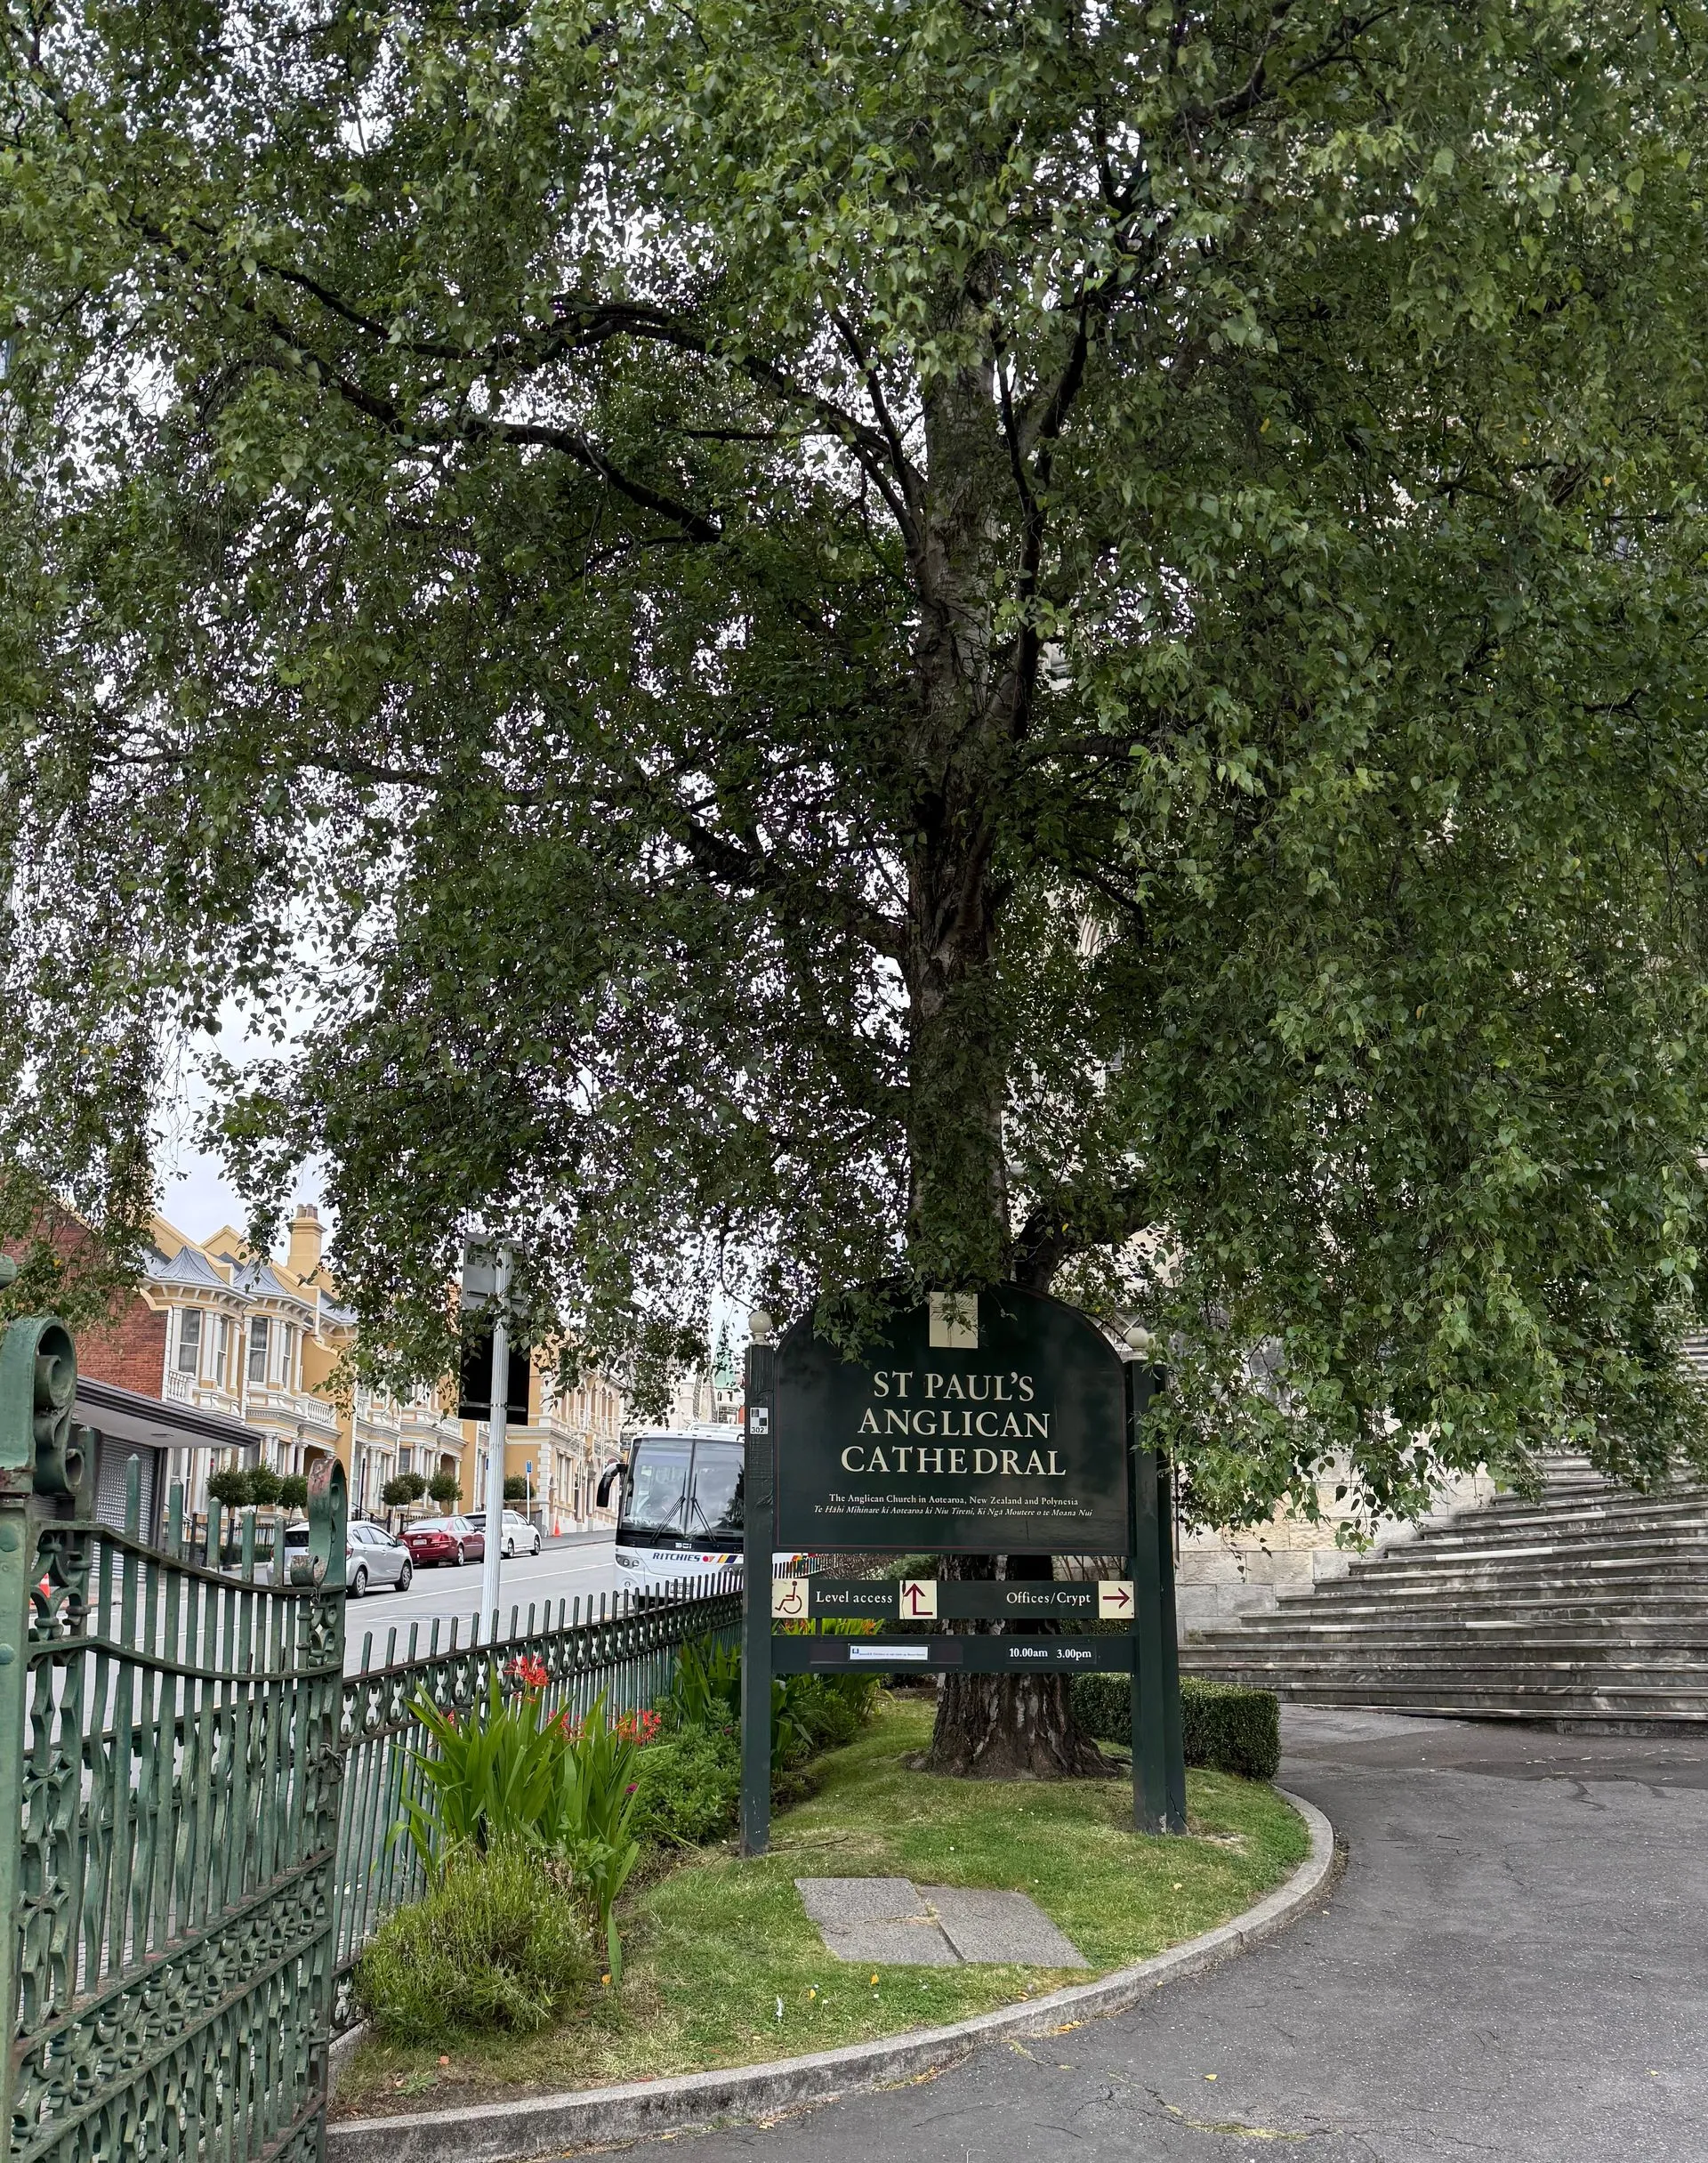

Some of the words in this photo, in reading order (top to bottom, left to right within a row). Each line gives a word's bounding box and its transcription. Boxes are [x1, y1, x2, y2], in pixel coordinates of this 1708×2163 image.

[874, 1370, 913, 1398] ST
[924, 1371, 1035, 1402] PAUL'S
[857, 1407, 1051, 1439] ANGLICAN
[841, 1445, 1067, 1476] CATHEDRAL
[829, 1493, 845, 1502] The
[848, 1494, 884, 1505] Anglican
[886, 1494, 916, 1504] Church
[919, 1495, 926, 1504] in
[928, 1495, 967, 1505] Aotearoa,
[969, 1496, 987, 1505] New
[990, 1496, 1022, 1505] Zealand
[1024, 1497, 1039, 1505] and
[1041, 1497, 1078, 1507] Polynesia
[814, 1505, 823, 1513] Te
[881, 1505, 890, 1514] ki
[890, 1506, 923, 1514] Aotearoa
[925, 1506, 933, 1514] ki
[934, 1506, 948, 1515] Niu
[977, 1507, 987, 1515] Ki
[1005, 1508, 1035, 1516] Moutere
[1051, 1508, 1076, 1517] Moana
[1078, 1509, 1093, 1517] Nui
[652, 1552, 701, 1562] RITCHIES
[816, 1590, 849, 1602] Level
[852, 1595, 893, 1603] access
[1006, 1591, 1091, 1606] Offices/Crypt
[1009, 1647, 1048, 1658] 10.00am
[1056, 1648, 1092, 1661] 3.00pm
